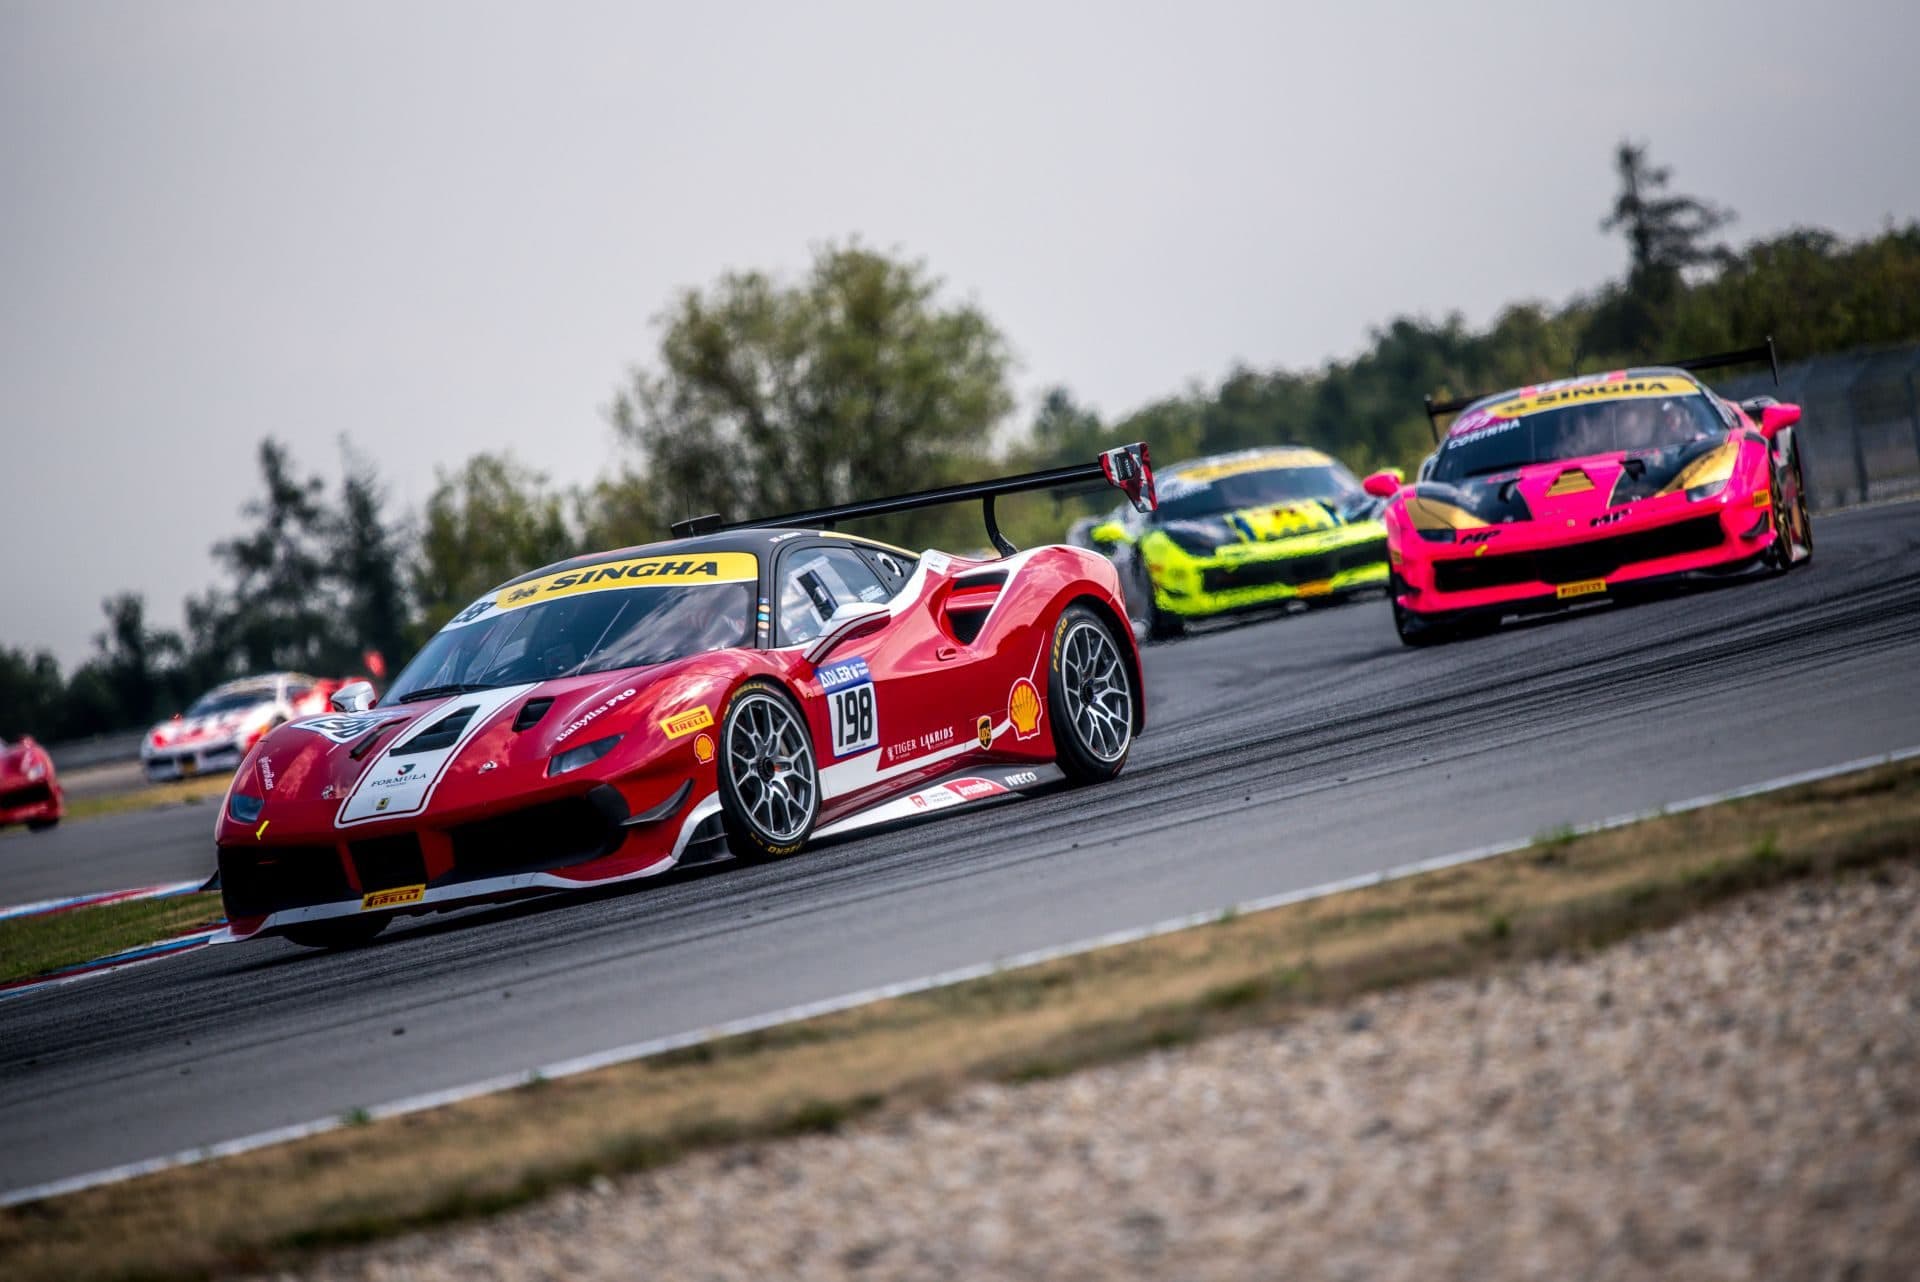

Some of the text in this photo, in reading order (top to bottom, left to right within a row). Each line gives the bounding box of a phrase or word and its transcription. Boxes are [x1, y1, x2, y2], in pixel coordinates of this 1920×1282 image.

[1536, 383, 1670, 405] SINGHA
[545, 561, 718, 591] SINGHA
[819, 665, 854, 688] ADLER
[667, 710, 709, 734] PIRELLI
[836, 687, 872, 747] 198
[894, 739, 917, 756] TIGER
[920, 726, 954, 751] LAKRIDS
[371, 773, 426, 787] FORMULA
[1004, 771, 1037, 787] IVECO
[365, 888, 420, 907] PIRELLI
